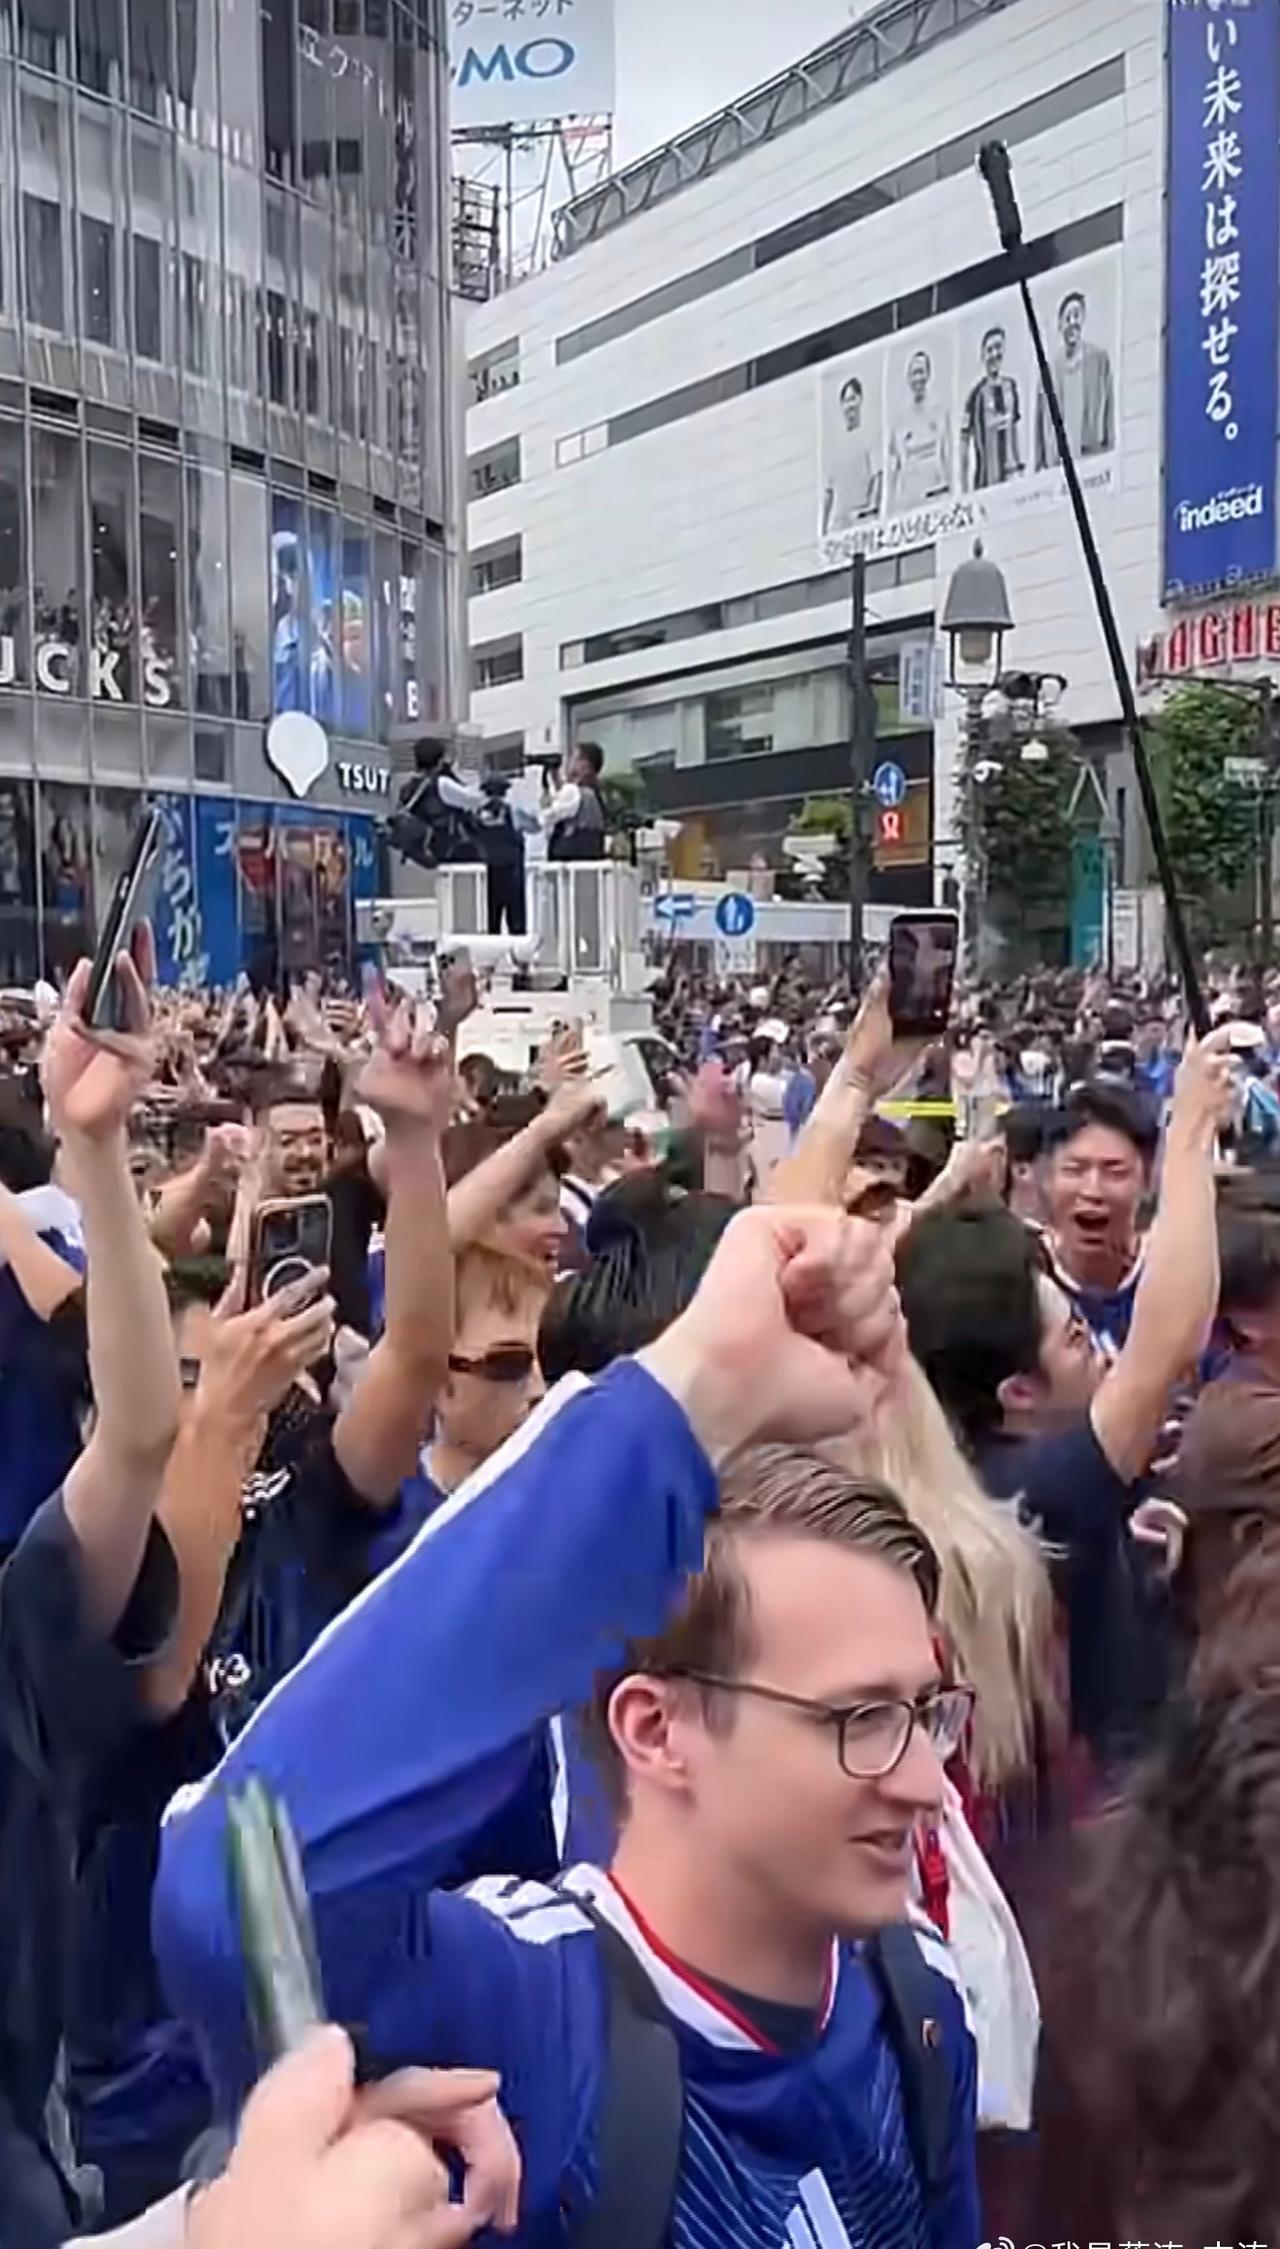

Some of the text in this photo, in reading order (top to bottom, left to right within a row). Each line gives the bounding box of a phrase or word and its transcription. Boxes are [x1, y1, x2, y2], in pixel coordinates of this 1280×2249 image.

[452, 38, 575, 87] MO
[1200, 19, 1242, 440] い未来は探せる。
[1178, 485, 1263, 532] indeed
[339, 762, 389, 794] TSUT
